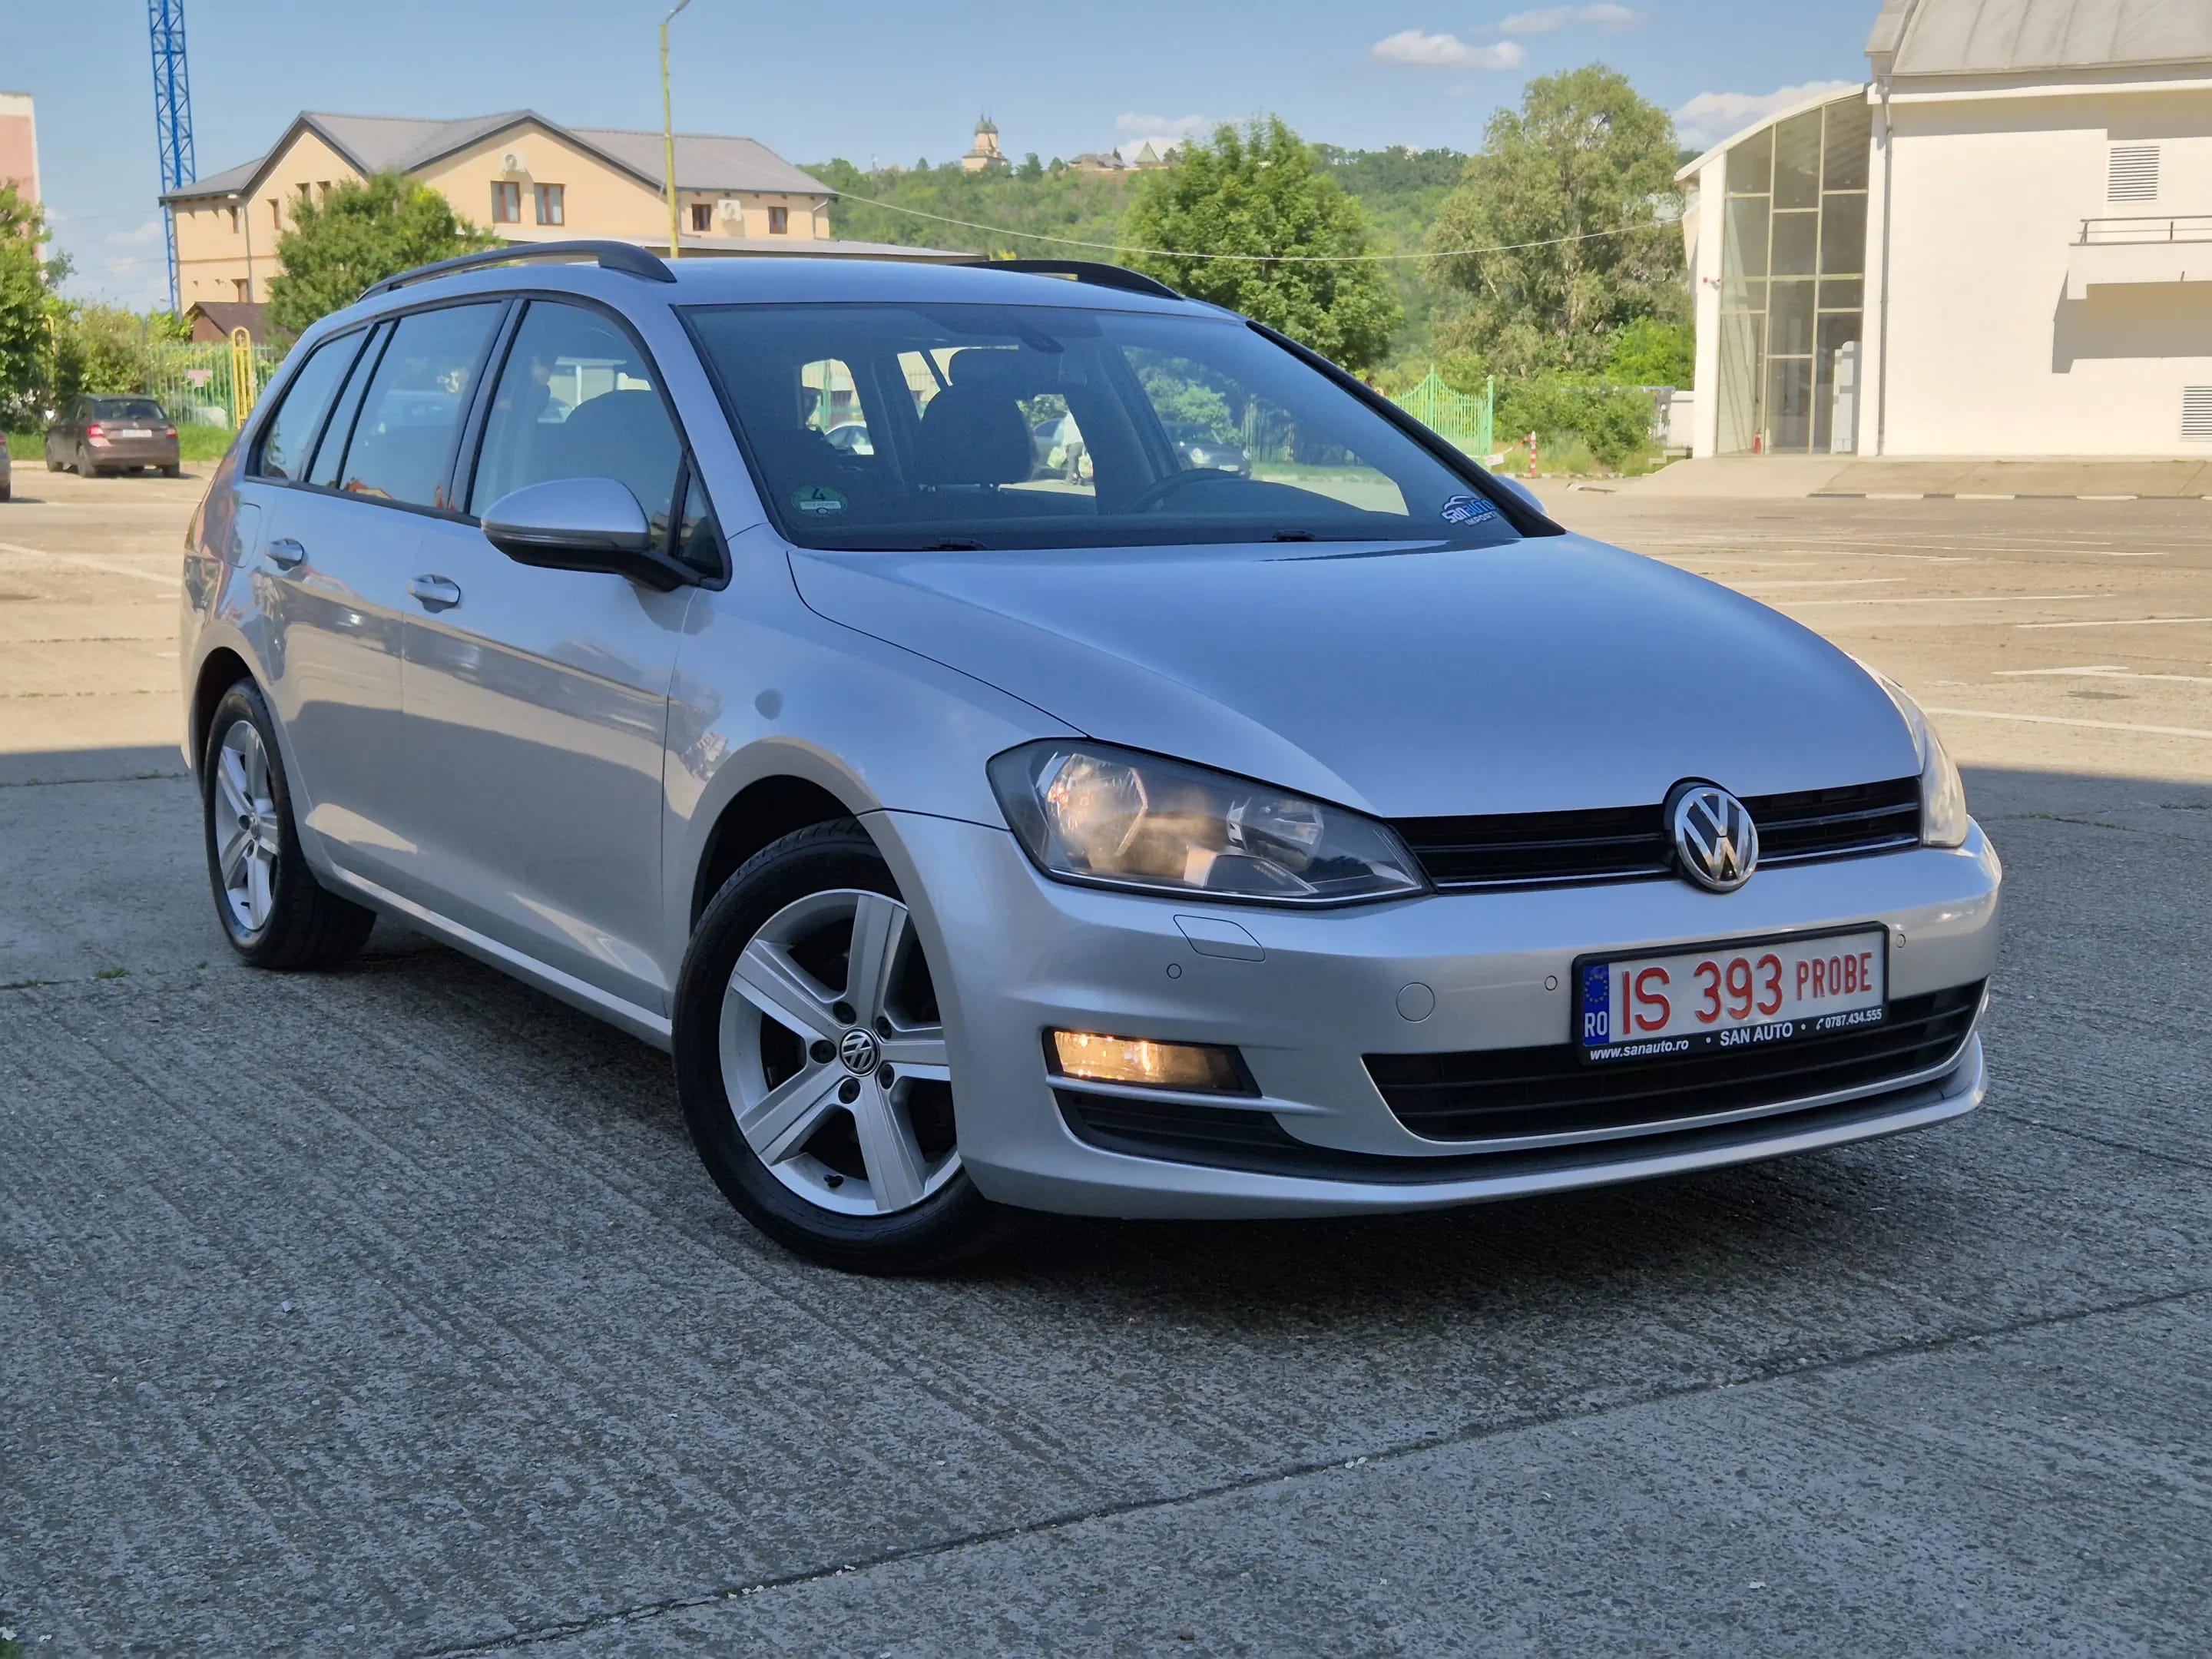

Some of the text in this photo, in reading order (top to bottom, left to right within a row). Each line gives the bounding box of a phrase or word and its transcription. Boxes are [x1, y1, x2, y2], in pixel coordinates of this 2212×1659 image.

[1623, 952, 1873, 1035] IS 393 PROBE
[1584, 1011, 1608, 1037] RO
[1590, 1008, 1883, 1061] www.sanauto.ro SAN AUTO 0787.434.555
